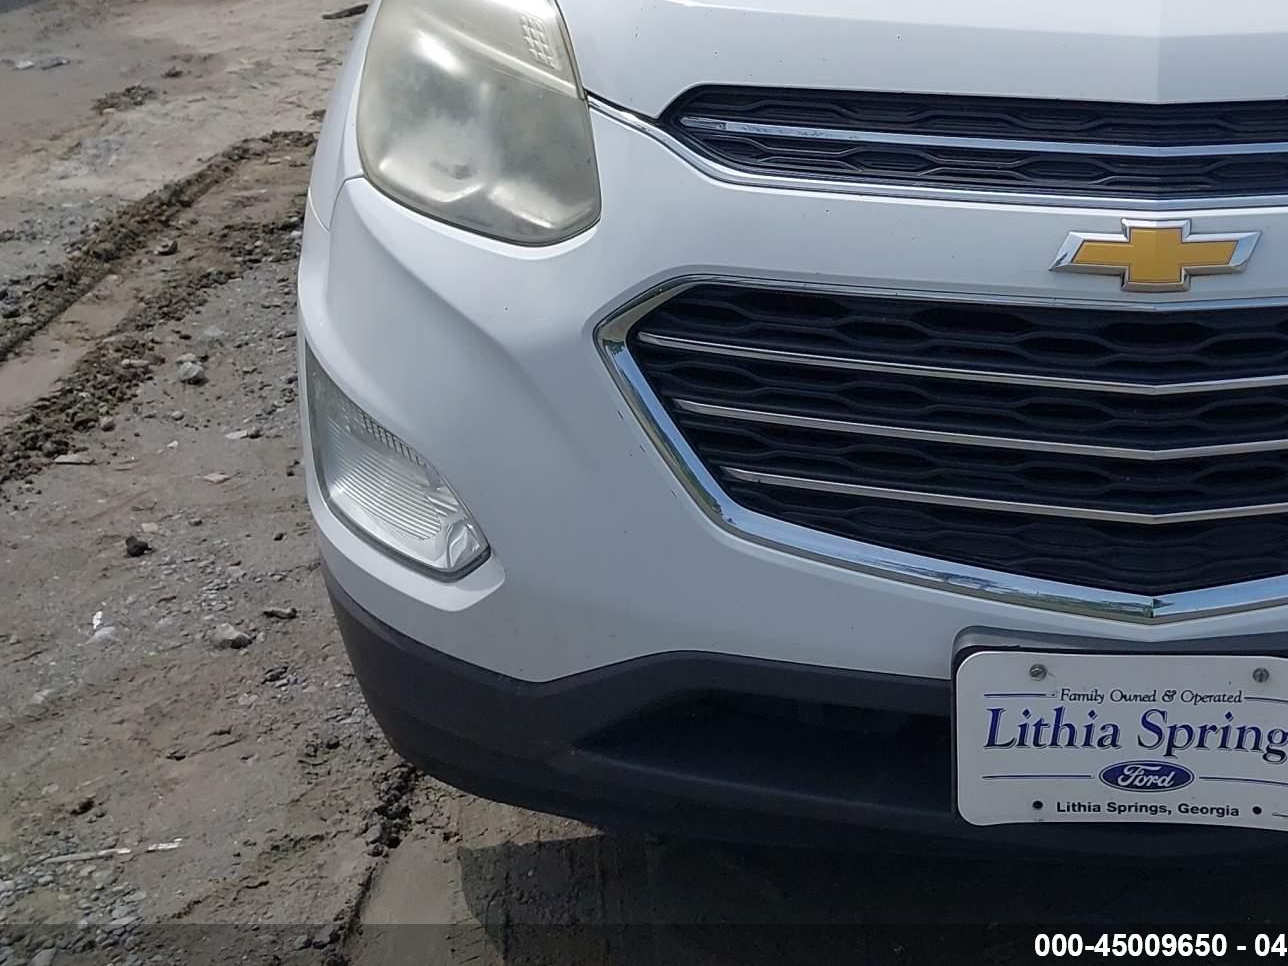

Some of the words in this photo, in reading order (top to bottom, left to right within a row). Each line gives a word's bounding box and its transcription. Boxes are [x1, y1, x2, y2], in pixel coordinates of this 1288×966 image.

[1060, 689, 1105, 705] Family
[1109, 689, 1157, 703] Owned
[1161, 689, 1177, 703] &
[1180, 690, 1243, 705] Operated
[983, 707, 1122, 750] Lithia
[1117, 764, 1176, 788] Ford
[1056, 801, 1102, 813] Lithia
[1106, 801, 1172, 815] Springs,
[1177, 803, 1240, 817] Georgia
